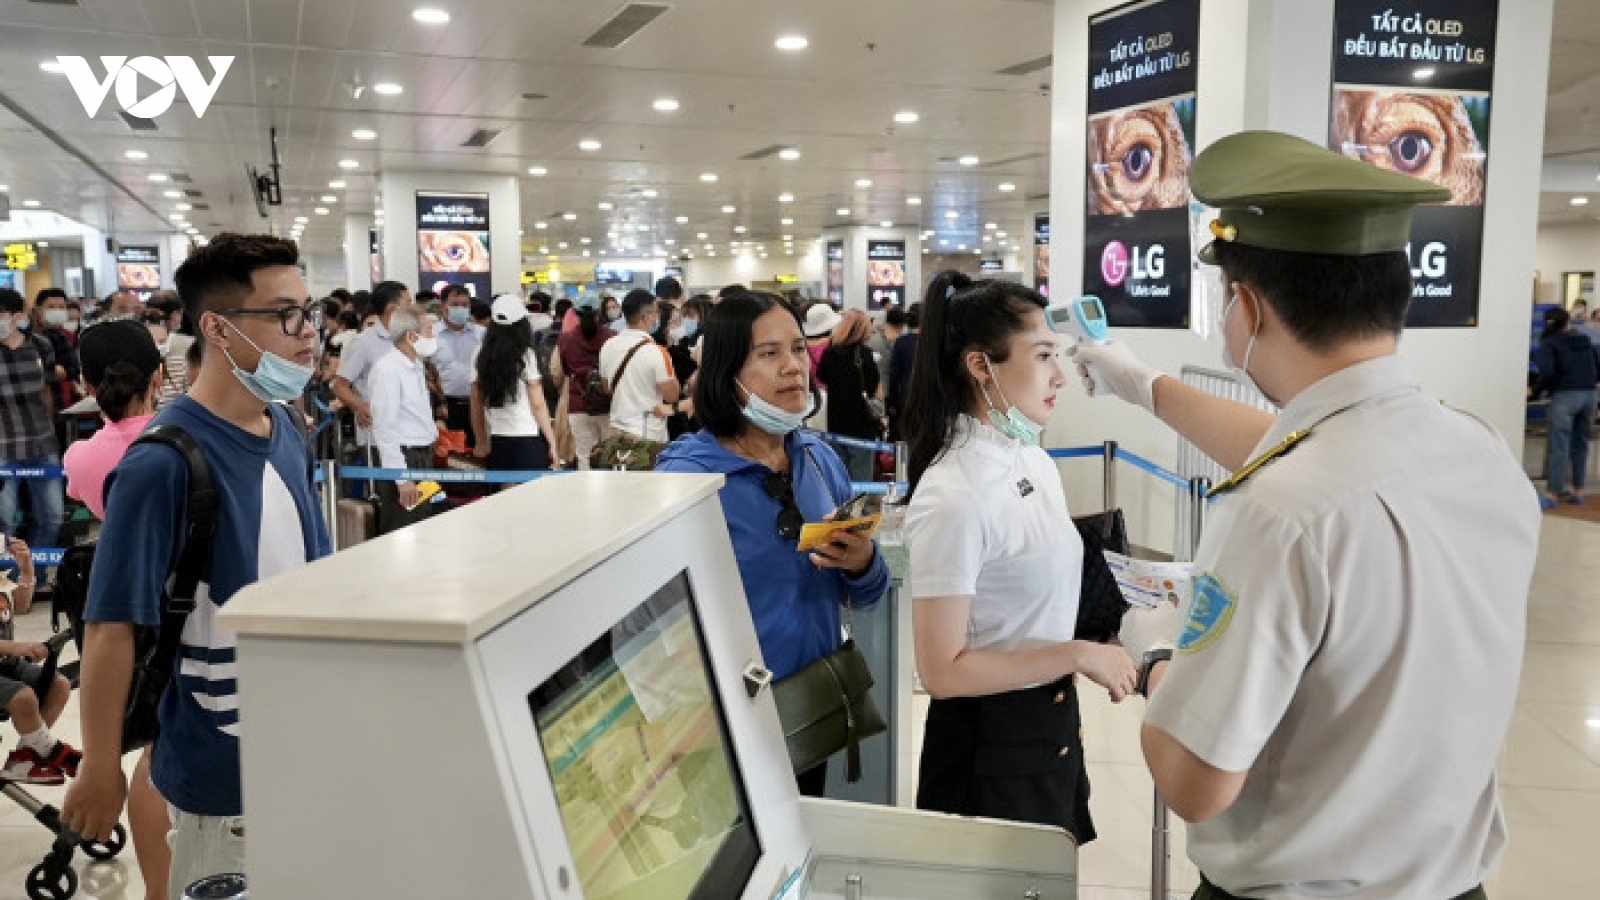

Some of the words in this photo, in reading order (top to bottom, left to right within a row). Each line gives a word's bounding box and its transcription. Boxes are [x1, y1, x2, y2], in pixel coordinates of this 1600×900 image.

[1371, 8, 1400, 33] TẤT
[1401, 12, 1423, 35] CẢ
[1425, 18, 1463, 36] OLED
[1144, 32, 1174, 52] OLED
[1344, 32, 1377, 56] ĐỀU
[1466, 47, 1485, 64] LG
[1175, 50, 1191, 69] LG
[1131, 244, 1165, 280] LG
[1425, 282, 1453, 298] Good
